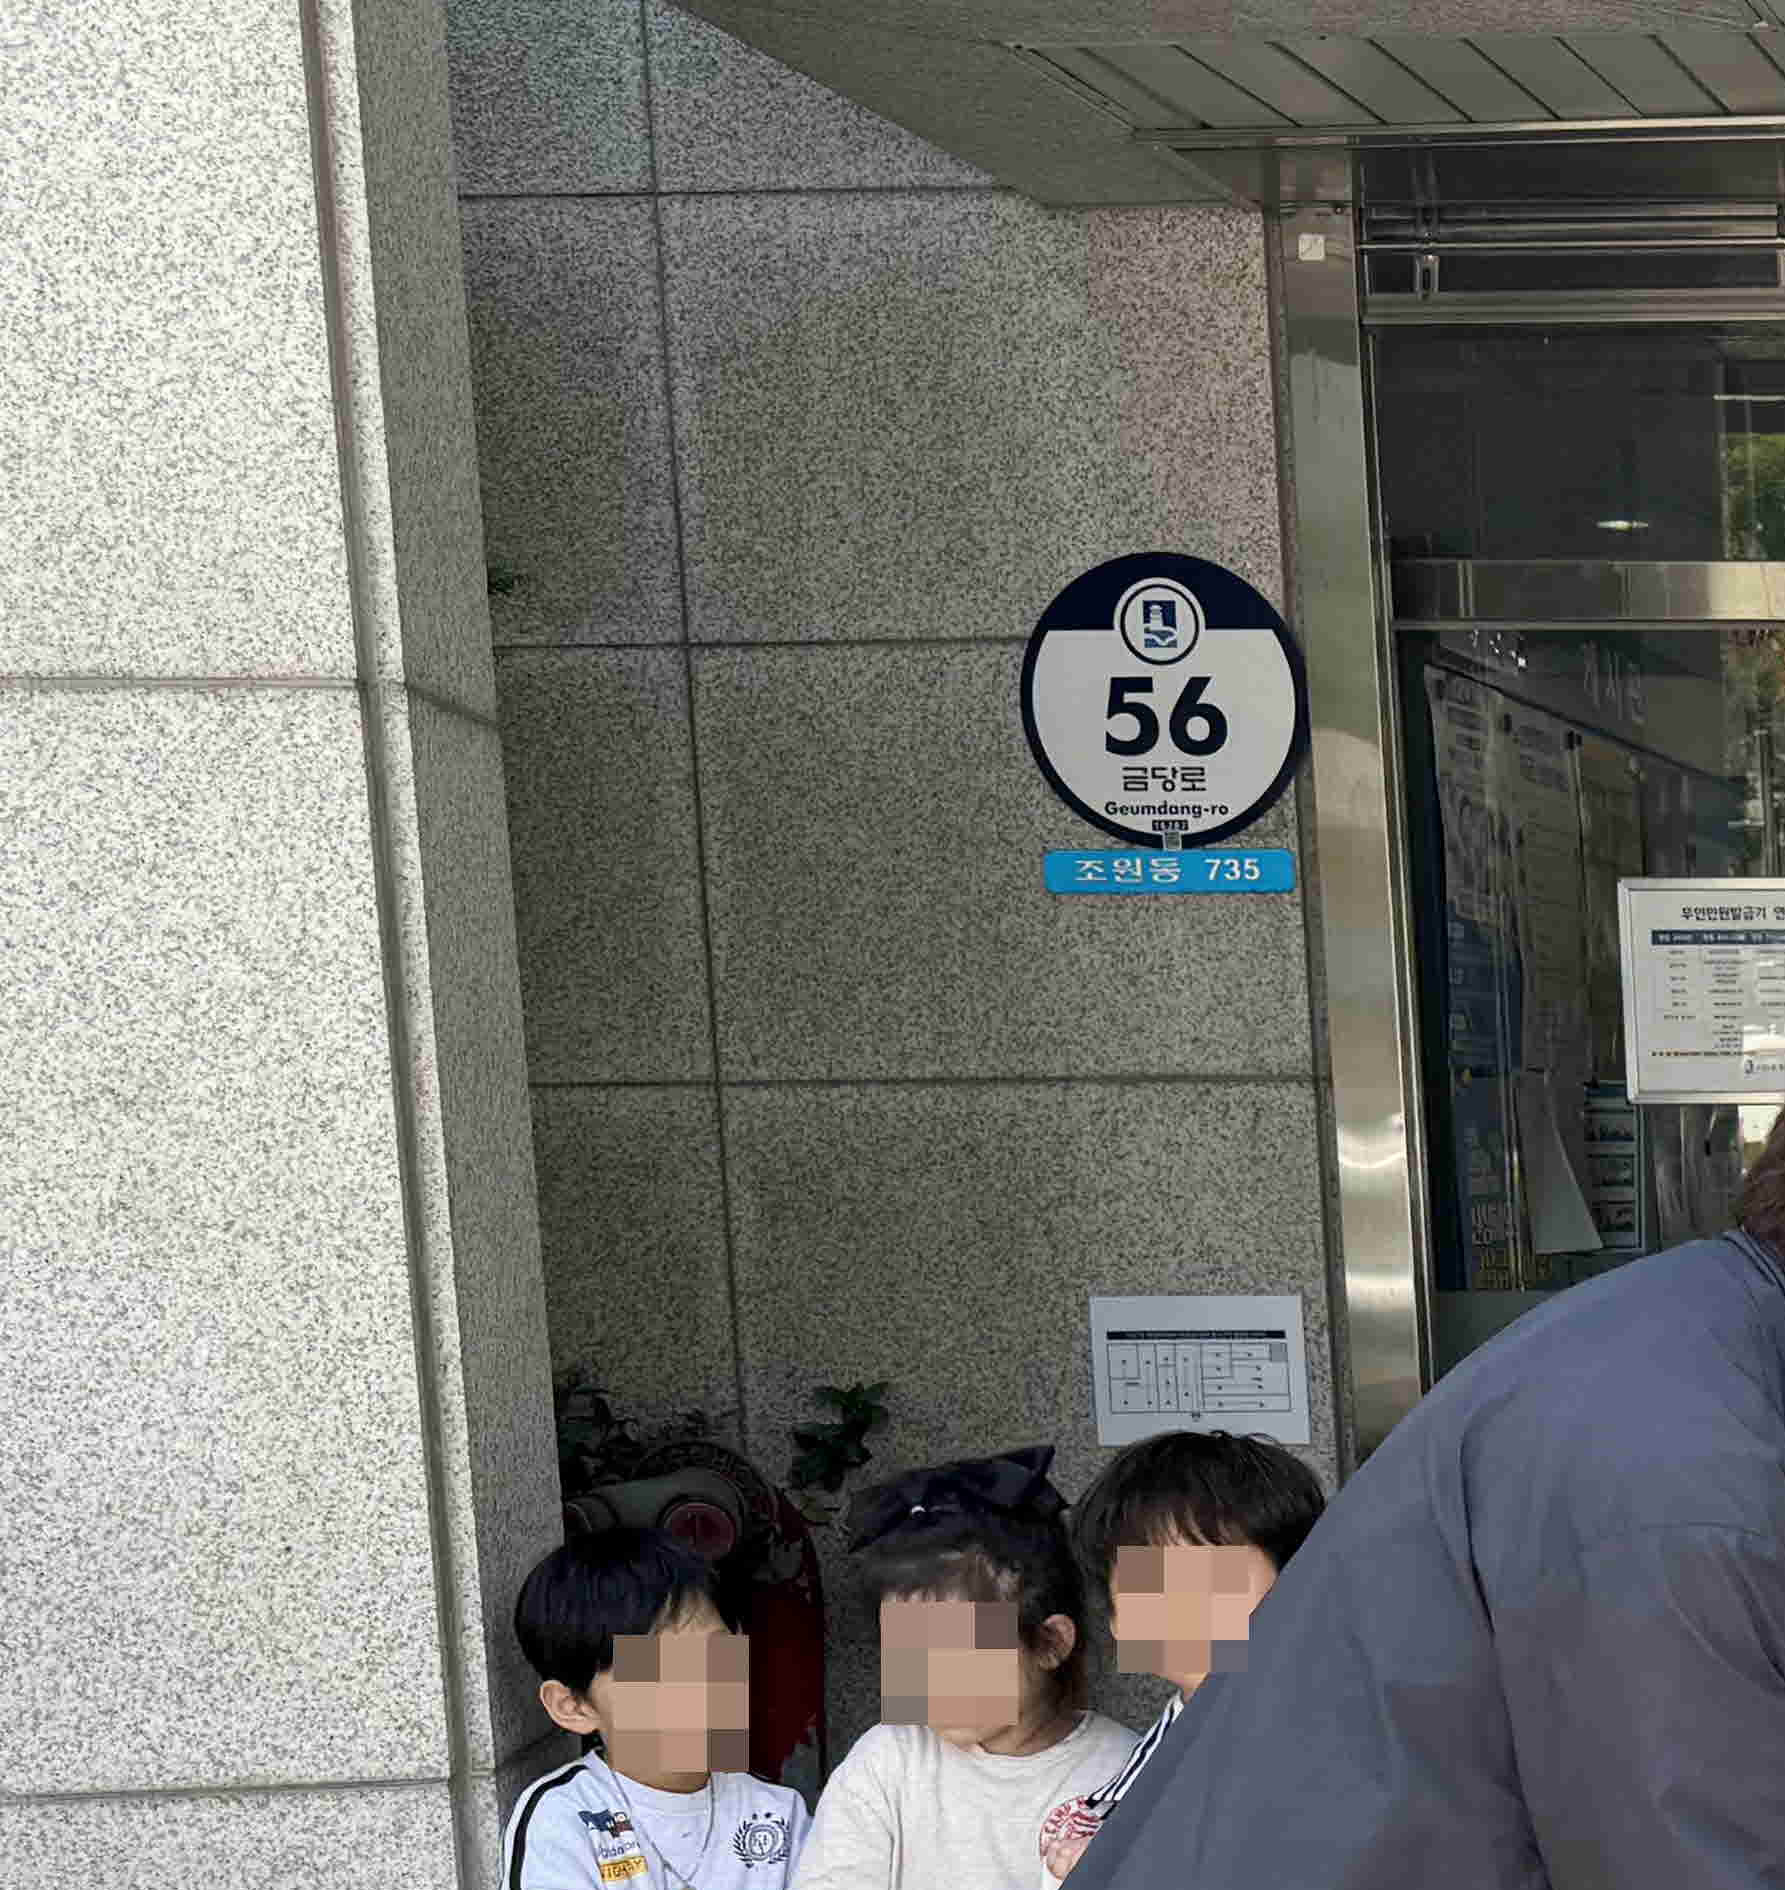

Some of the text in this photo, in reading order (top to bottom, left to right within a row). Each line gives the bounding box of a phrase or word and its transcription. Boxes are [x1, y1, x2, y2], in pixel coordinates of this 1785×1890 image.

[1105, 677, 1227, 755] 56
[1122, 766, 1206, 792] 금당로
[1105, 801, 1229, 818] Geumdang-ro
[1075, 856, 1261, 883] 조원동 735
